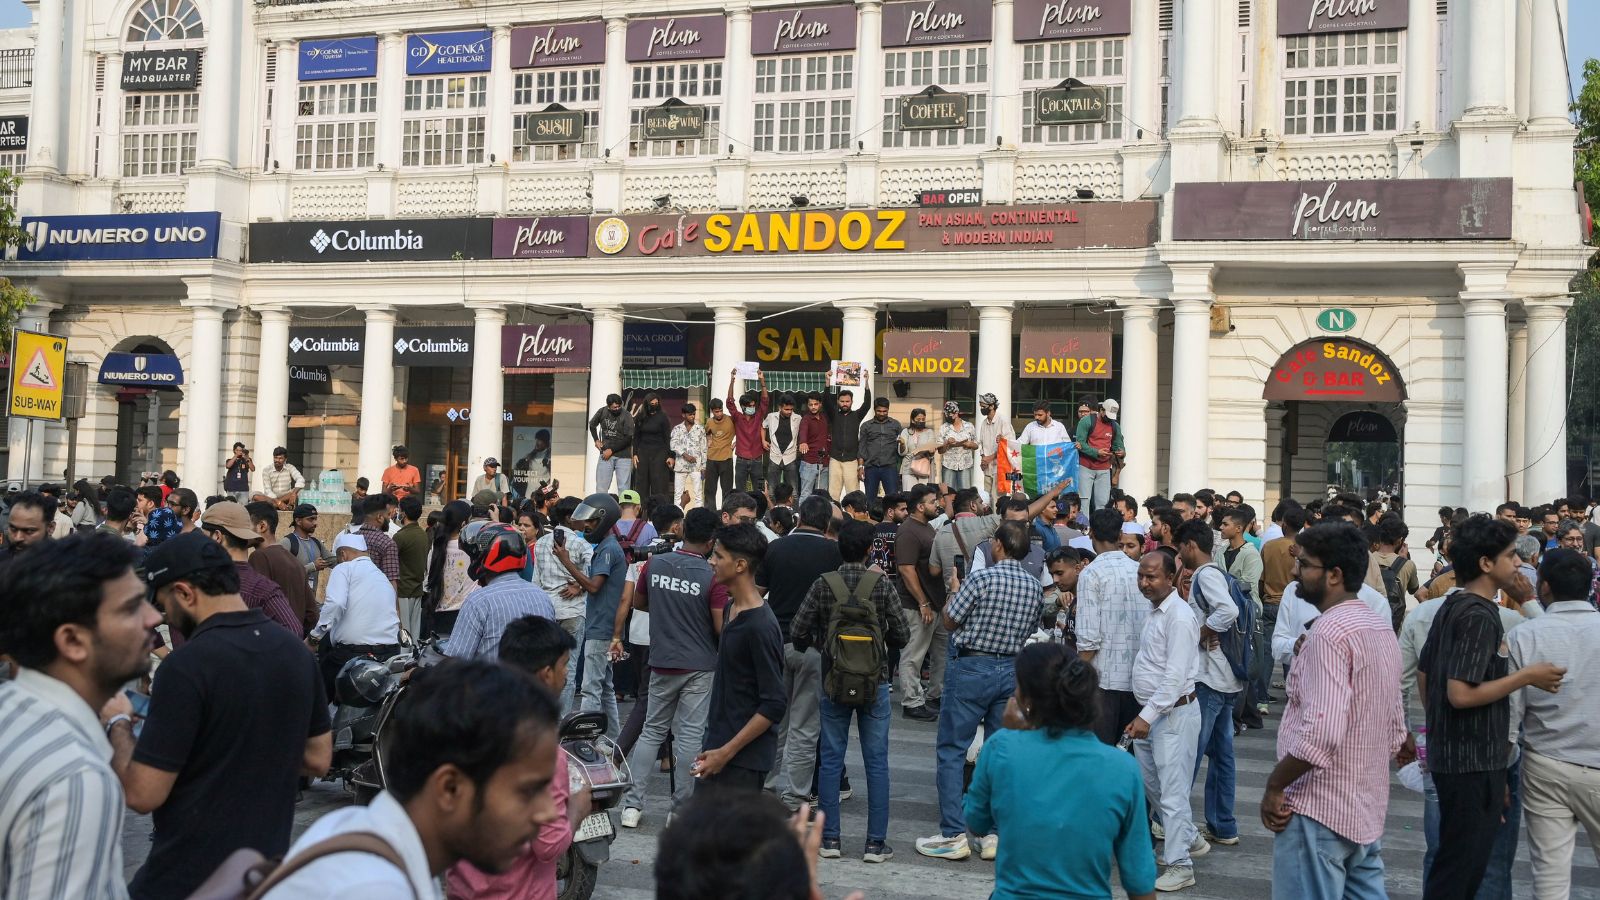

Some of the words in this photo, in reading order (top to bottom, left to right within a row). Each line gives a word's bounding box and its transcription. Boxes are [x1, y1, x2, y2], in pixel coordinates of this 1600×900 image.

[906, 1, 965, 42] plum
[1039, 0, 1102, 36] plum
[647, 18, 701, 57] plum
[773, 10, 830, 50] plum
[411, 46, 428, 57] GD
[438, 43, 485, 56] GOENKA
[528, 27, 581, 65] plum
[129, 57, 152, 72] MY
[155, 56, 188, 71] BAR
[437, 55, 485, 64] HEALTHCARE
[123, 73, 191, 84] HEADQUARTER
[910, 102, 956, 119] COFFEE
[1041, 96, 1102, 115] COCKTAILS
[536, 118, 573, 136] SUSHI
[647, 117, 667, 128] BEER
[679, 116, 701, 129] WINE
[922, 193, 945, 204] BAR
[948, 192, 979, 203] OPEN
[1292, 181, 1380, 236] plum
[918, 212, 943, 227] PAN
[945, 211, 987, 228] ASIAN,
[990, 209, 1079, 226] CONTINENTAL
[50, 227, 149, 245] NUMERO
[154, 226, 207, 243] UNO
[331, 229, 424, 251] Columbia
[512, 217, 565, 256] plum
[638, 214, 700, 255] Cafe
[703, 210, 906, 253] SANDOZ
[941, 231, 950, 245] &
[953, 230, 1007, 245] MODERN
[1009, 230, 1054, 244] INDIAN
[1328, 311, 1344, 329] N
[302, 337, 360, 352] Columbia
[408, 337, 469, 353] Columbia
[516, 324, 575, 367] plum
[651, 333, 684, 343] GROUP
[887, 357, 965, 374] SANDOZ
[1024, 358, 1107, 374] SANDOZ
[1276, 348, 1318, 384] Cafe
[1323, 342, 1391, 385] Sandoz
[103, 372, 150, 380] NUMERO
[151, 373, 176, 381] UNO
[289, 365, 327, 382] Columbia
[1303, 372, 1319, 387] &
[1323, 371, 1365, 387] BAR
[14, 395, 57, 412] SUB-WAY
[651, 573, 701, 597] PRESS
